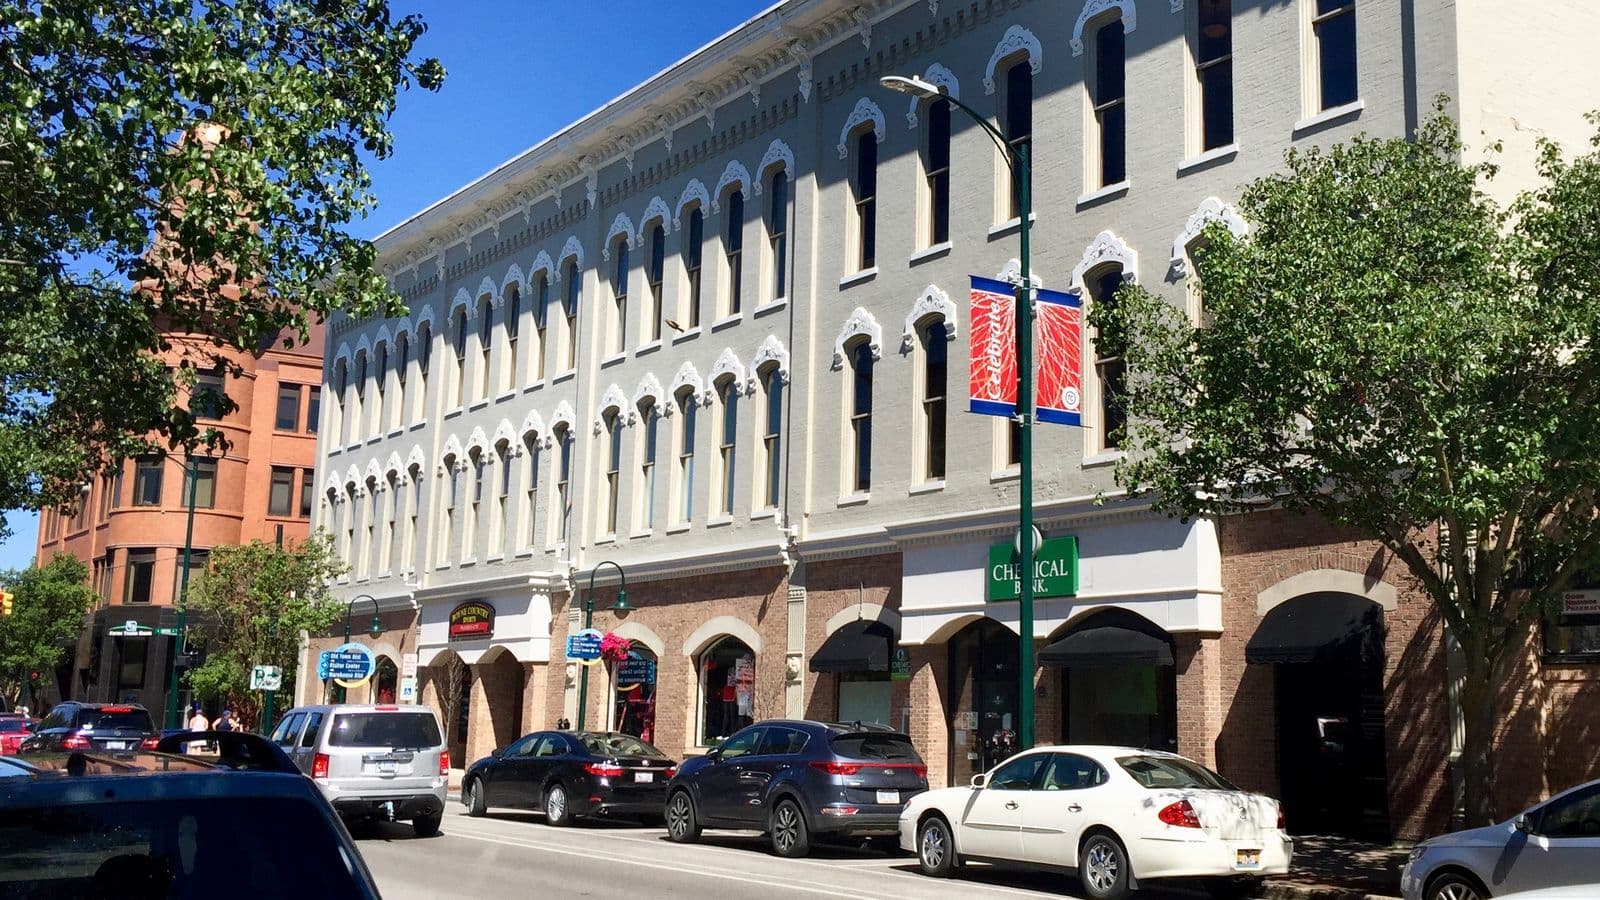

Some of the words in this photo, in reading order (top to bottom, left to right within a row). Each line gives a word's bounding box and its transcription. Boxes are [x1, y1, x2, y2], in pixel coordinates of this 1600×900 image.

[987, 301, 1002, 400] Celebrate
[992, 559, 1068, 581] CHEICAL
[467, 606, 489, 618] COUNTRY
